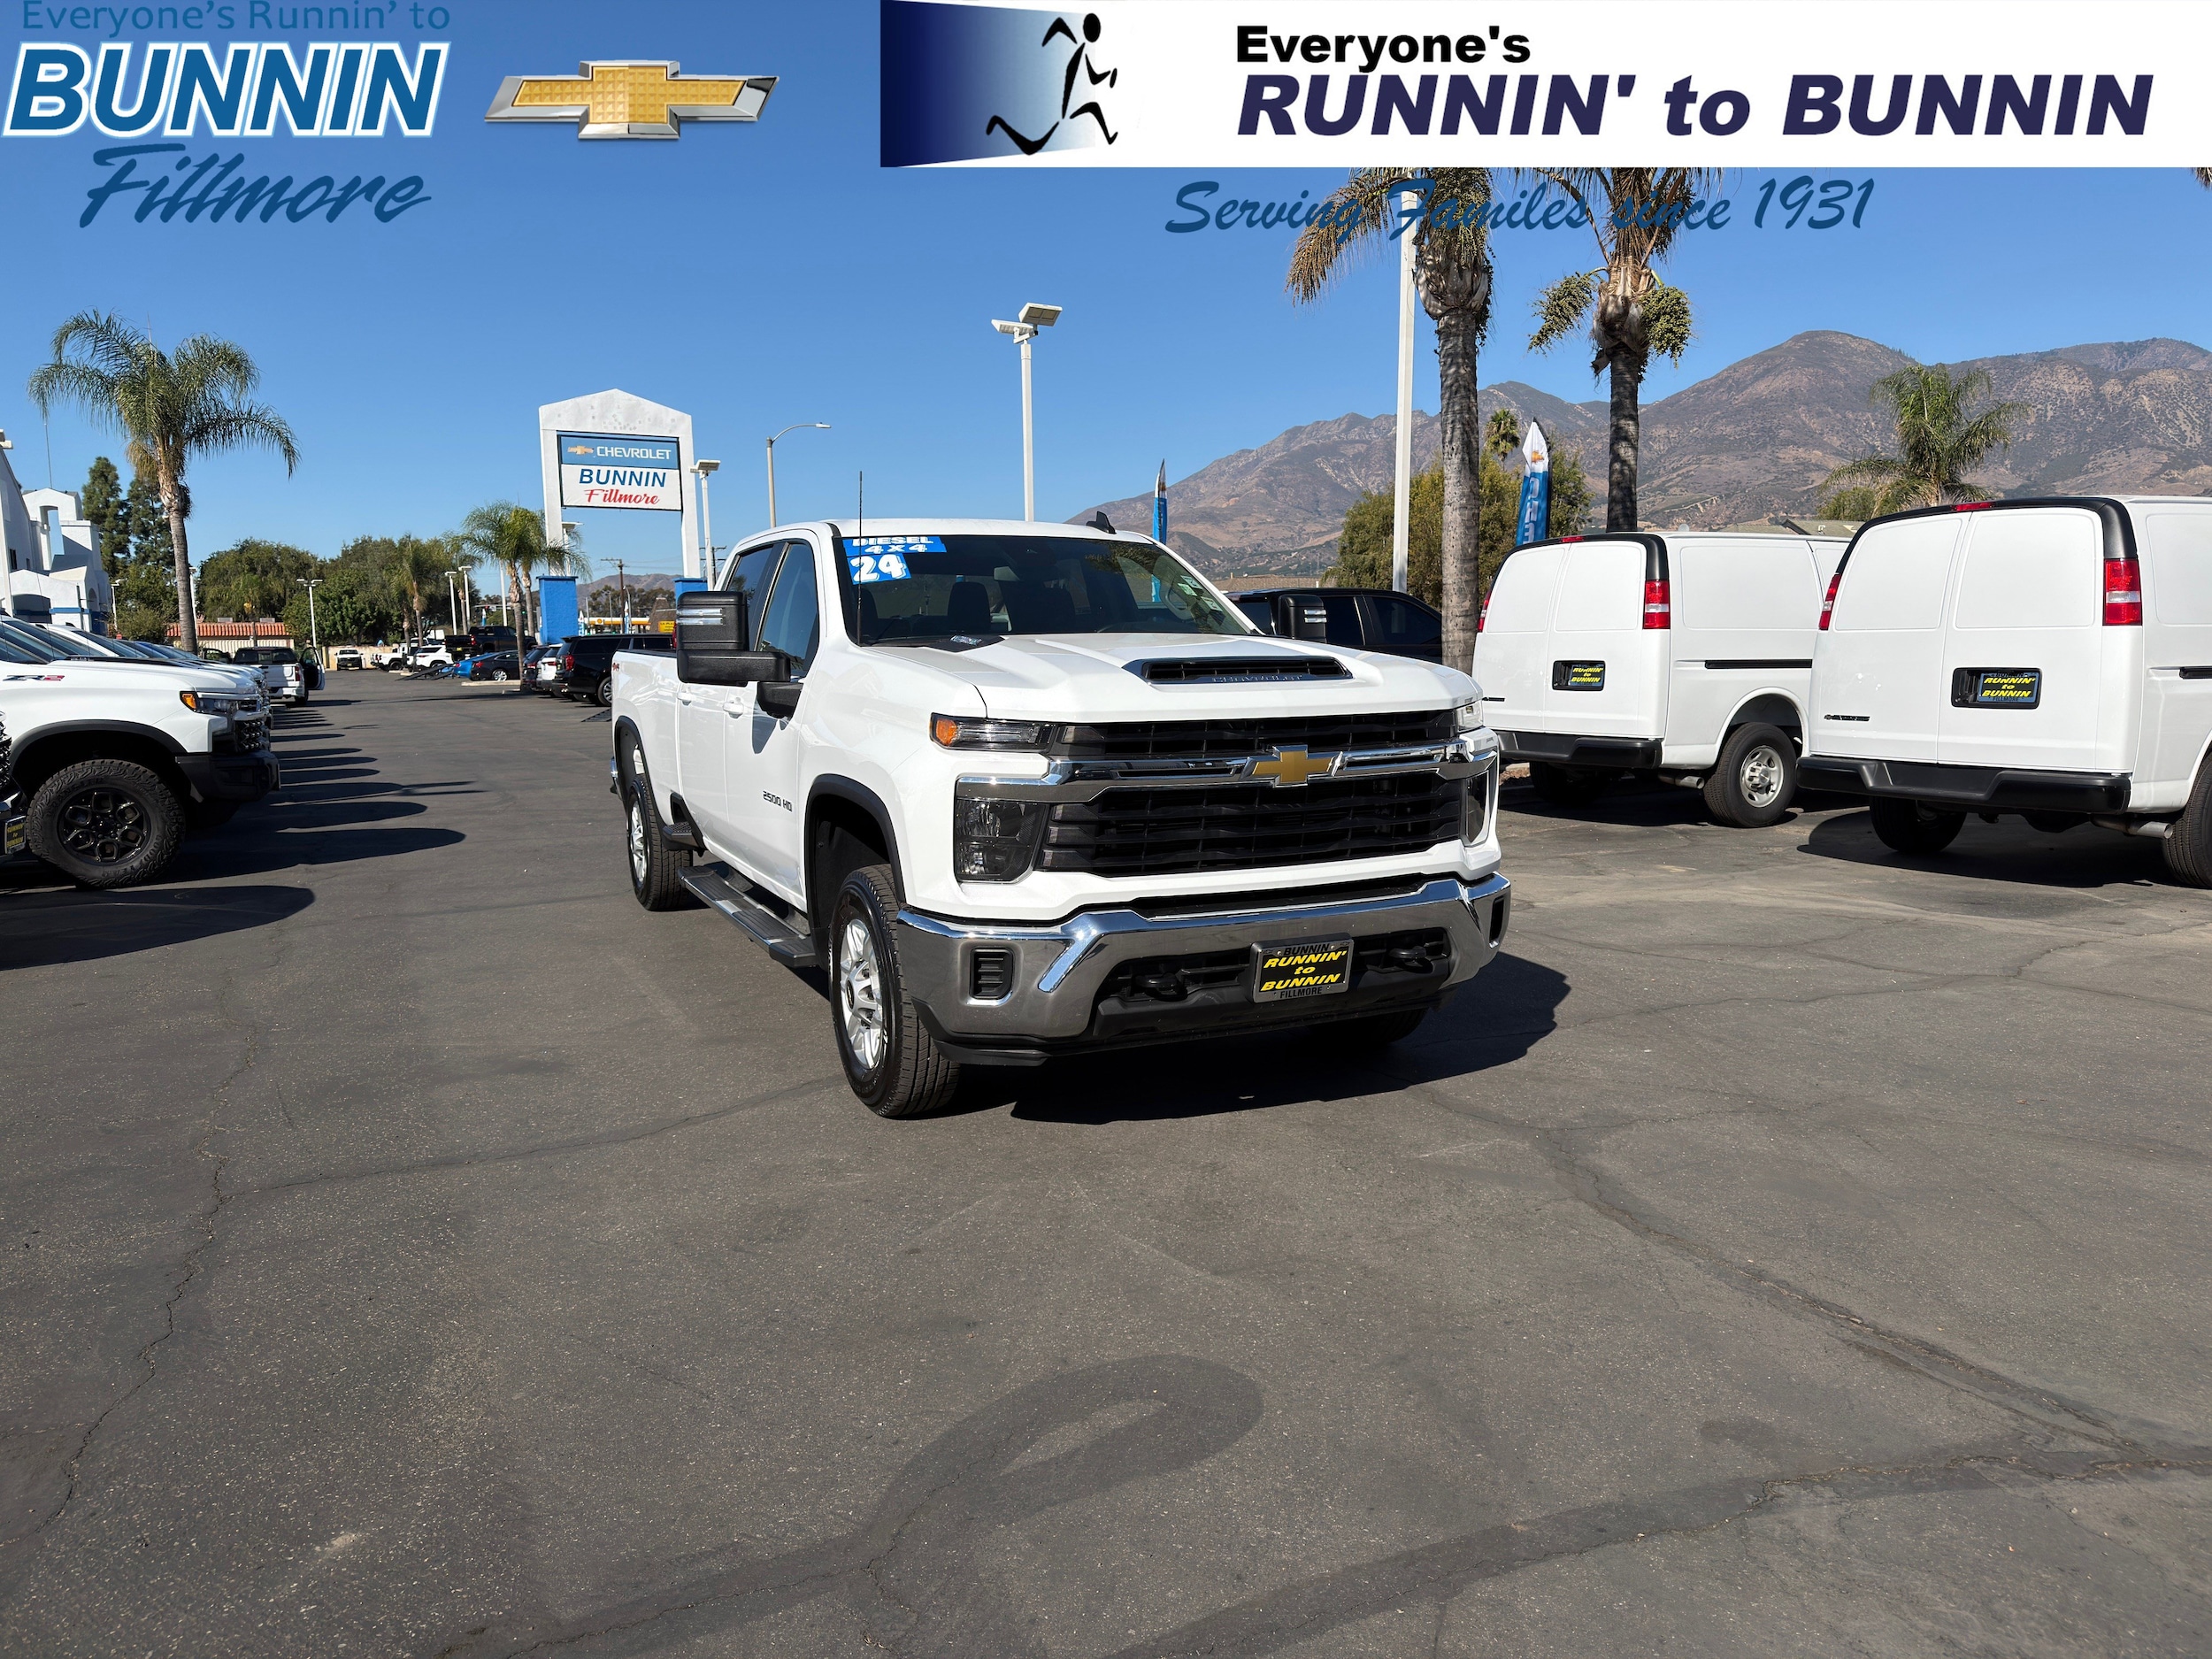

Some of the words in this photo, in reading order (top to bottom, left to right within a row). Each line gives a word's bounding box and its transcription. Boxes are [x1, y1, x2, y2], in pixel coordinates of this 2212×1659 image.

[596, 446, 672, 460] CHEVROLET
[579, 468, 666, 488] BUNNIN
[584, 488, 660, 505] Fillmore
[852, 536, 933, 547] DIESEL
[849, 554, 907, 583] 24
[763, 790, 781, 807] 2500
[782, 798, 793, 812] HD
[1284, 943, 1330, 956] BUNNIN
[1263, 950, 1347, 969] RUNNIN'
[1294, 966, 1316, 975] to
[1260, 973, 1341, 991] BUNNIN
[1280, 987, 1323, 999] FILLMORE
